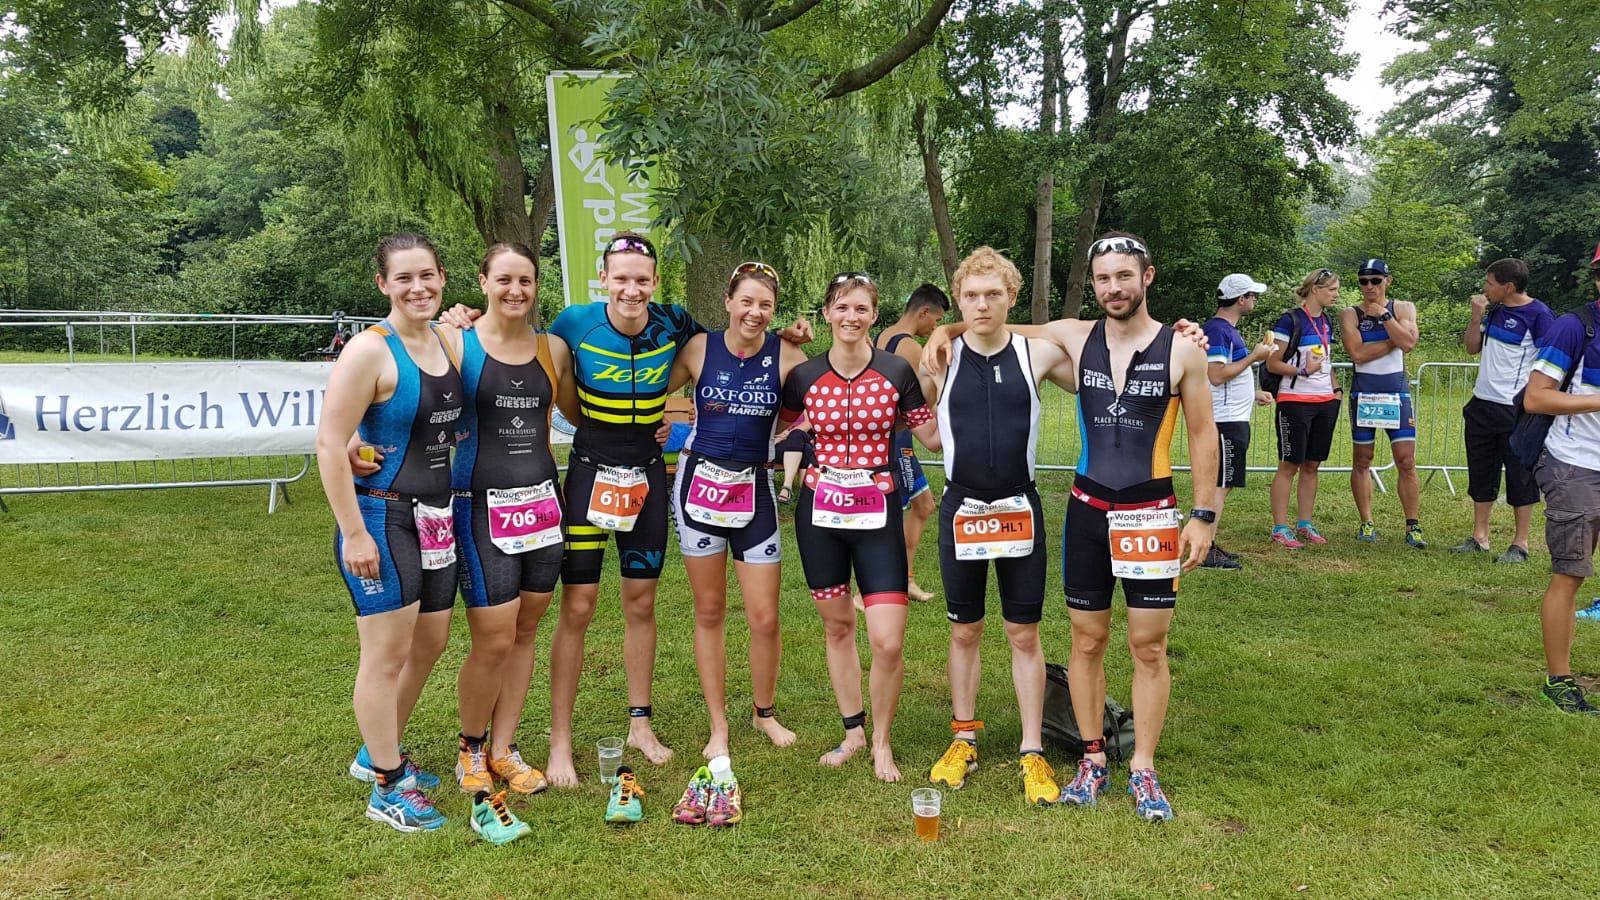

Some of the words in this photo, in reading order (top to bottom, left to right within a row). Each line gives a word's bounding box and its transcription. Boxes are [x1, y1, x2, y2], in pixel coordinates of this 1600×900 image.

[701, 385, 777, 404] OXFORD
[495, 399, 540, 409] GIESSEN
[35, 390, 225, 432] Herzlich
[237, 389, 325, 428] Wil
[727, 407, 772, 416] HARDER
[1114, 511, 1168, 522] Woogsprint
